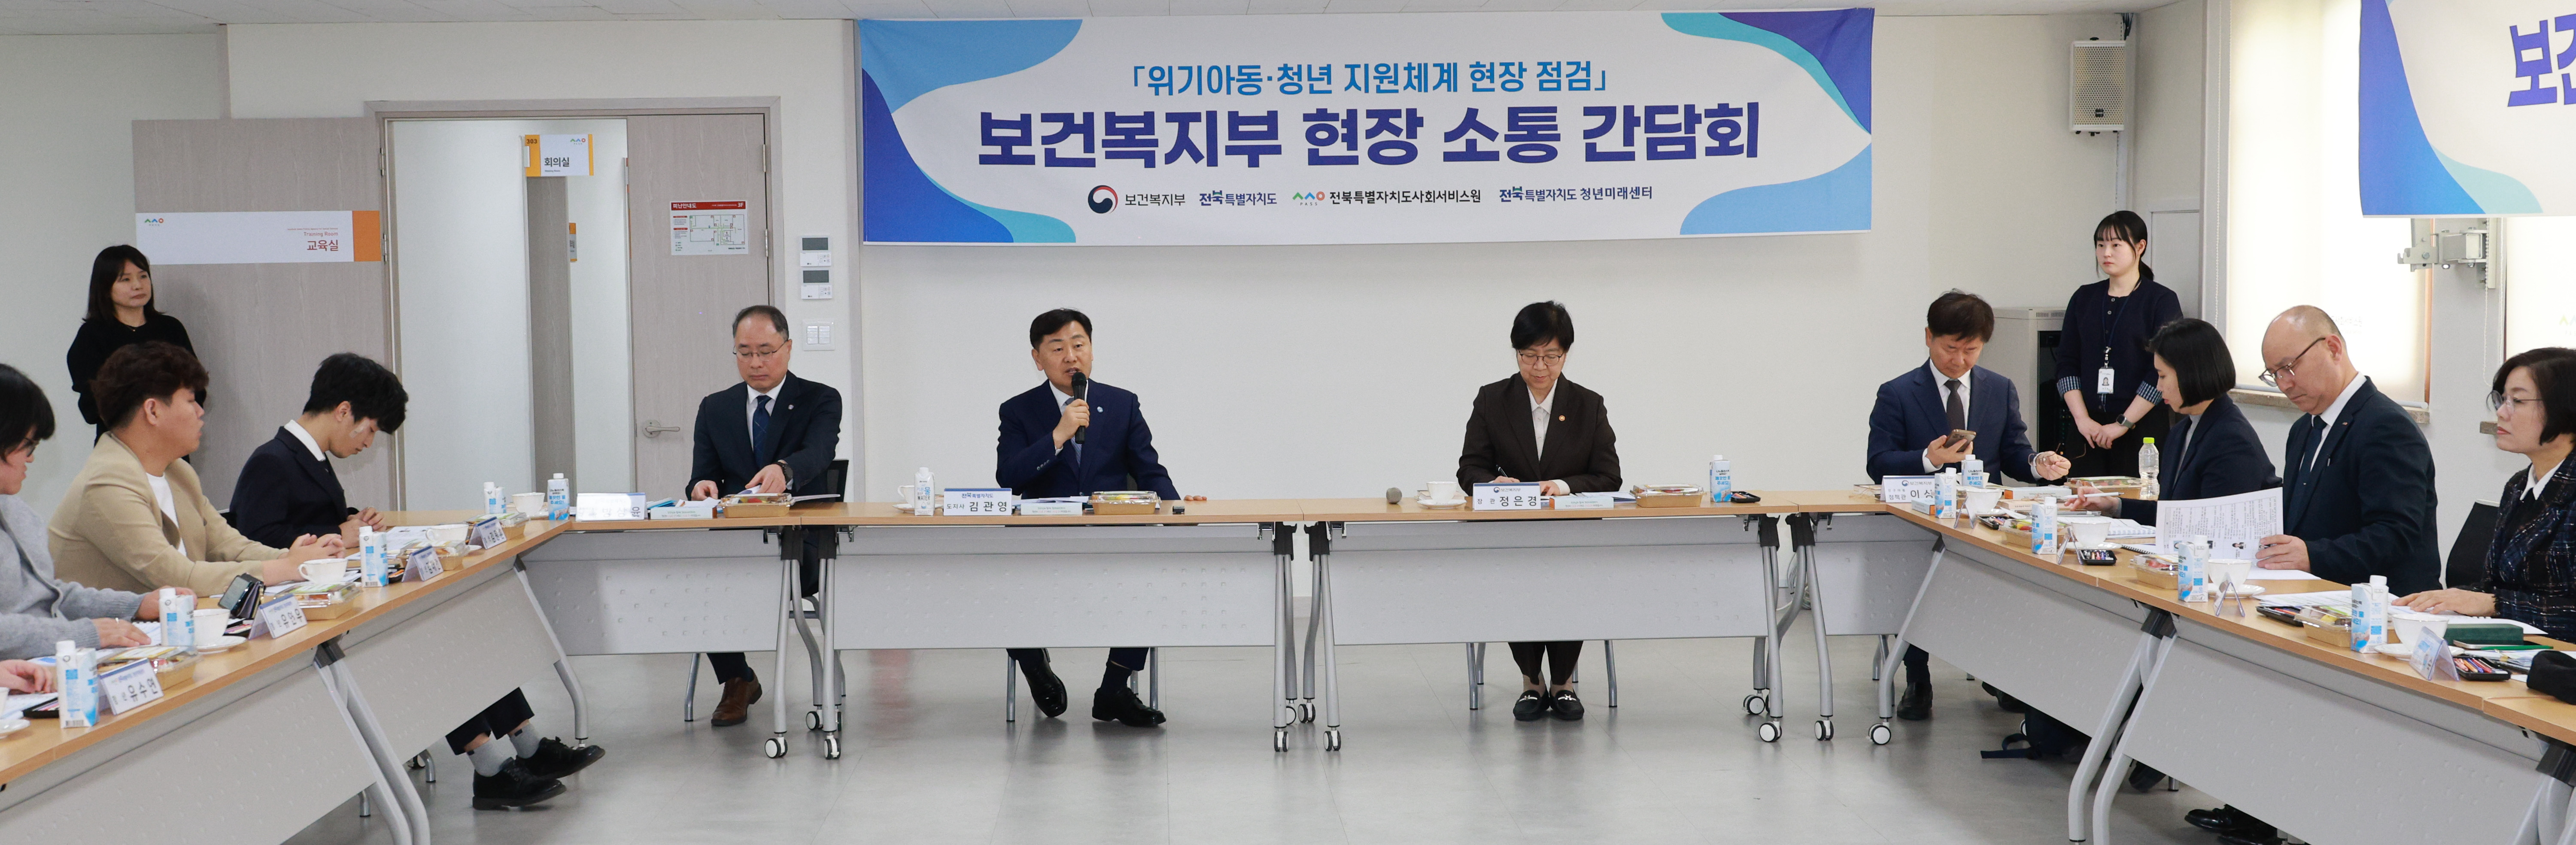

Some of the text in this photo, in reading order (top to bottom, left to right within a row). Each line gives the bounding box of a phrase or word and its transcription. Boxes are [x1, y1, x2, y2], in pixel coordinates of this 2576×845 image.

[1345, 62, 1458, 94] 지원체계
[1469, 61, 1527, 92] 현장
[1536, 61, 1606, 91] 점검」
[978, 102, 1759, 168] 보건복지부 현장 소통 간담회
[544, 157, 569, 167] 회의실
[1125, 194, 1185, 206] 보건복지부
[1200, 190, 1277, 206] 전북특별자치도
[1330, 189, 1480, 204] 전북특별자치도사회서비스원
[1499, 186, 1652, 202] 전북특별자치도 청년미래센터
[307, 239, 338, 251] 교육실
